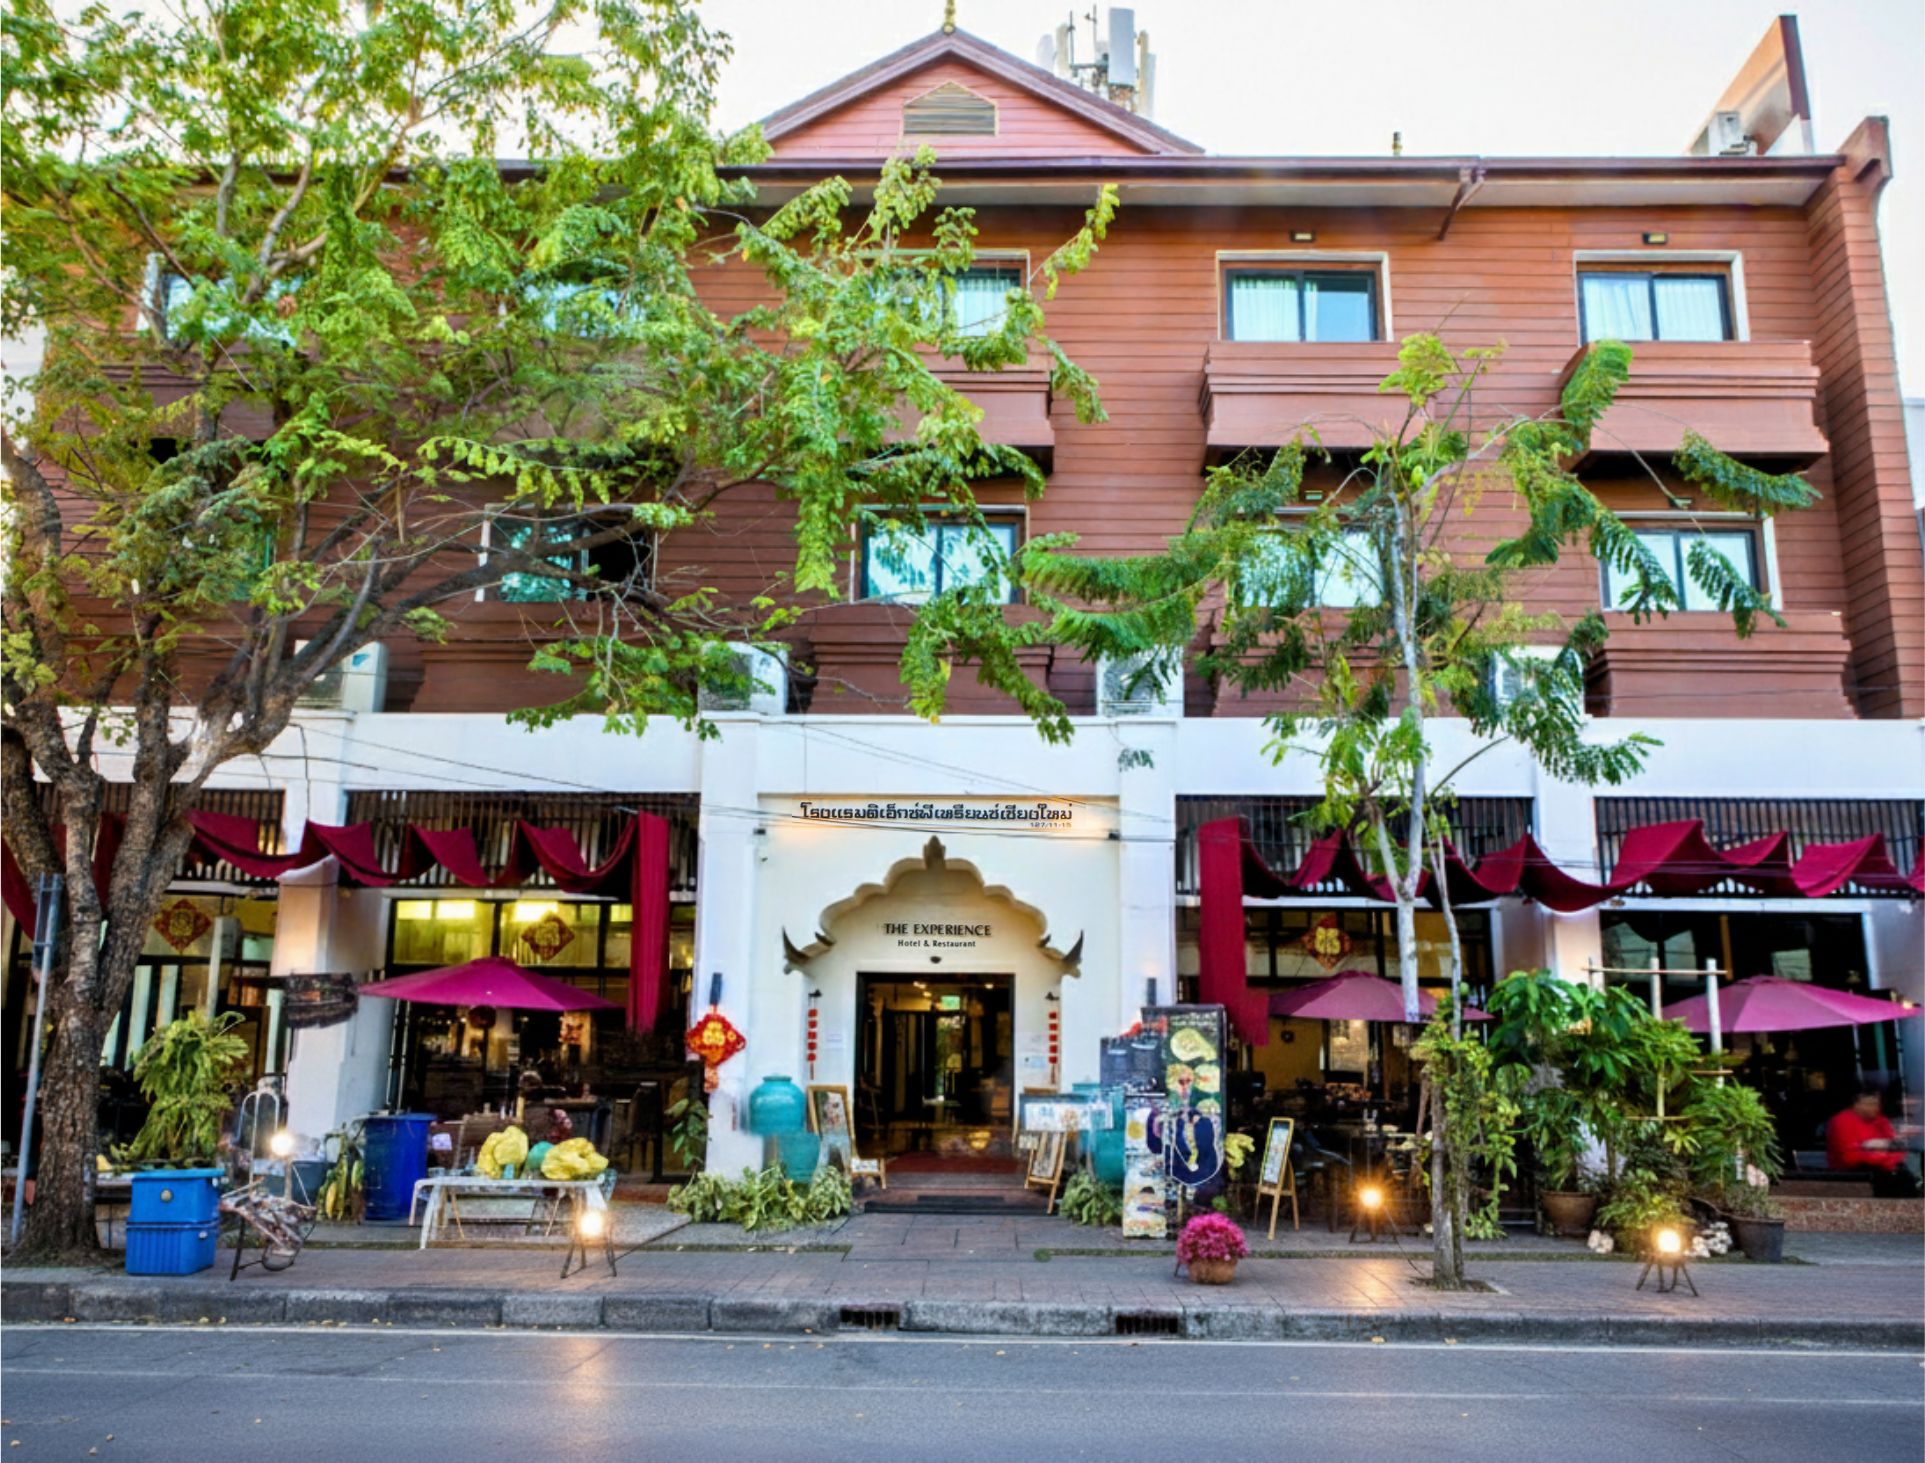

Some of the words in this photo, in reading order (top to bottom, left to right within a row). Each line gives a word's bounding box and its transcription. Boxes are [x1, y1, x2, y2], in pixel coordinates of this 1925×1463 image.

[884, 923, 908, 935] THE
[913, 923, 992, 936] EXPERIENCE
[897, 939, 921, 947] Hotel
[932, 939, 976, 948] Restaurant
